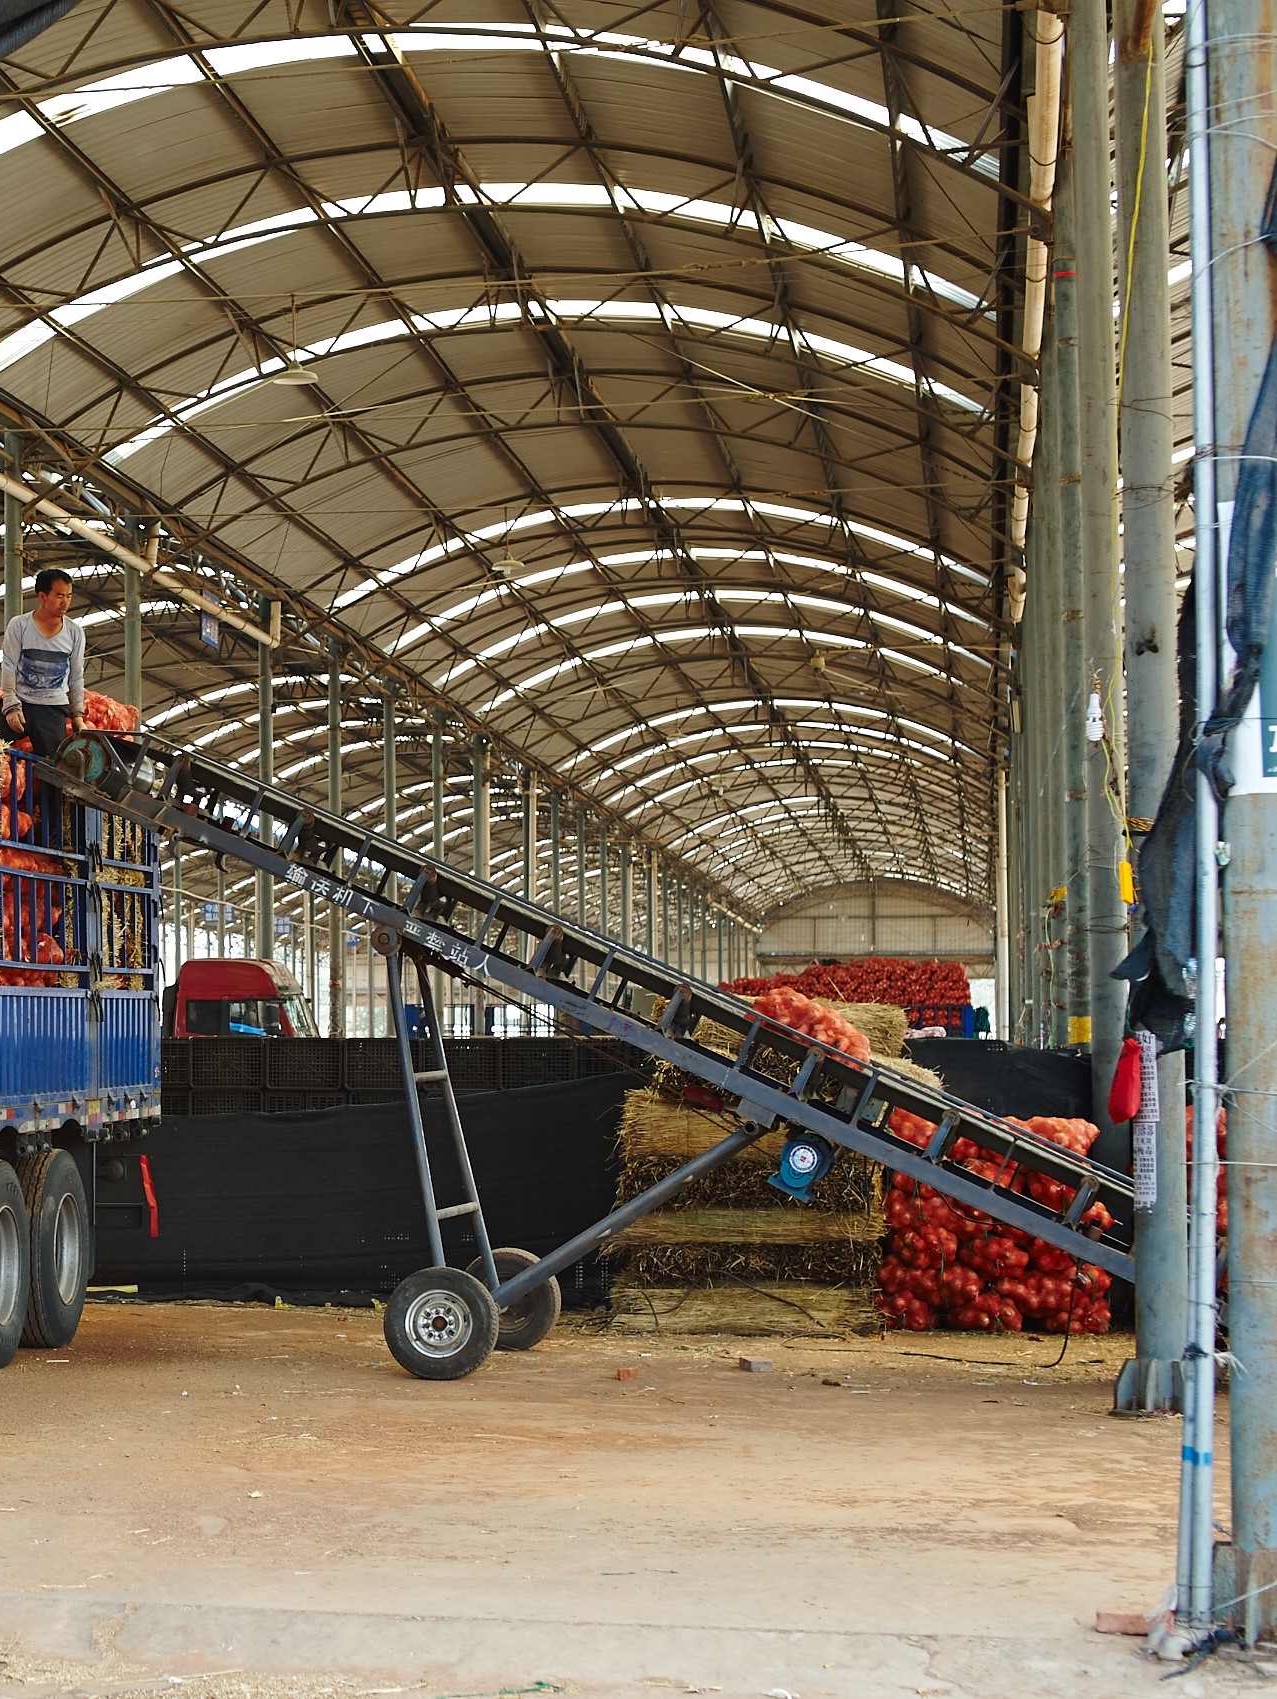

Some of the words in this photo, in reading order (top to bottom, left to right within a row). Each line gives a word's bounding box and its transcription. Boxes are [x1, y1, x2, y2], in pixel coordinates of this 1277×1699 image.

[284, 863, 380, 916] 输送机下
[404, 920, 491, 977] 严禁站人
